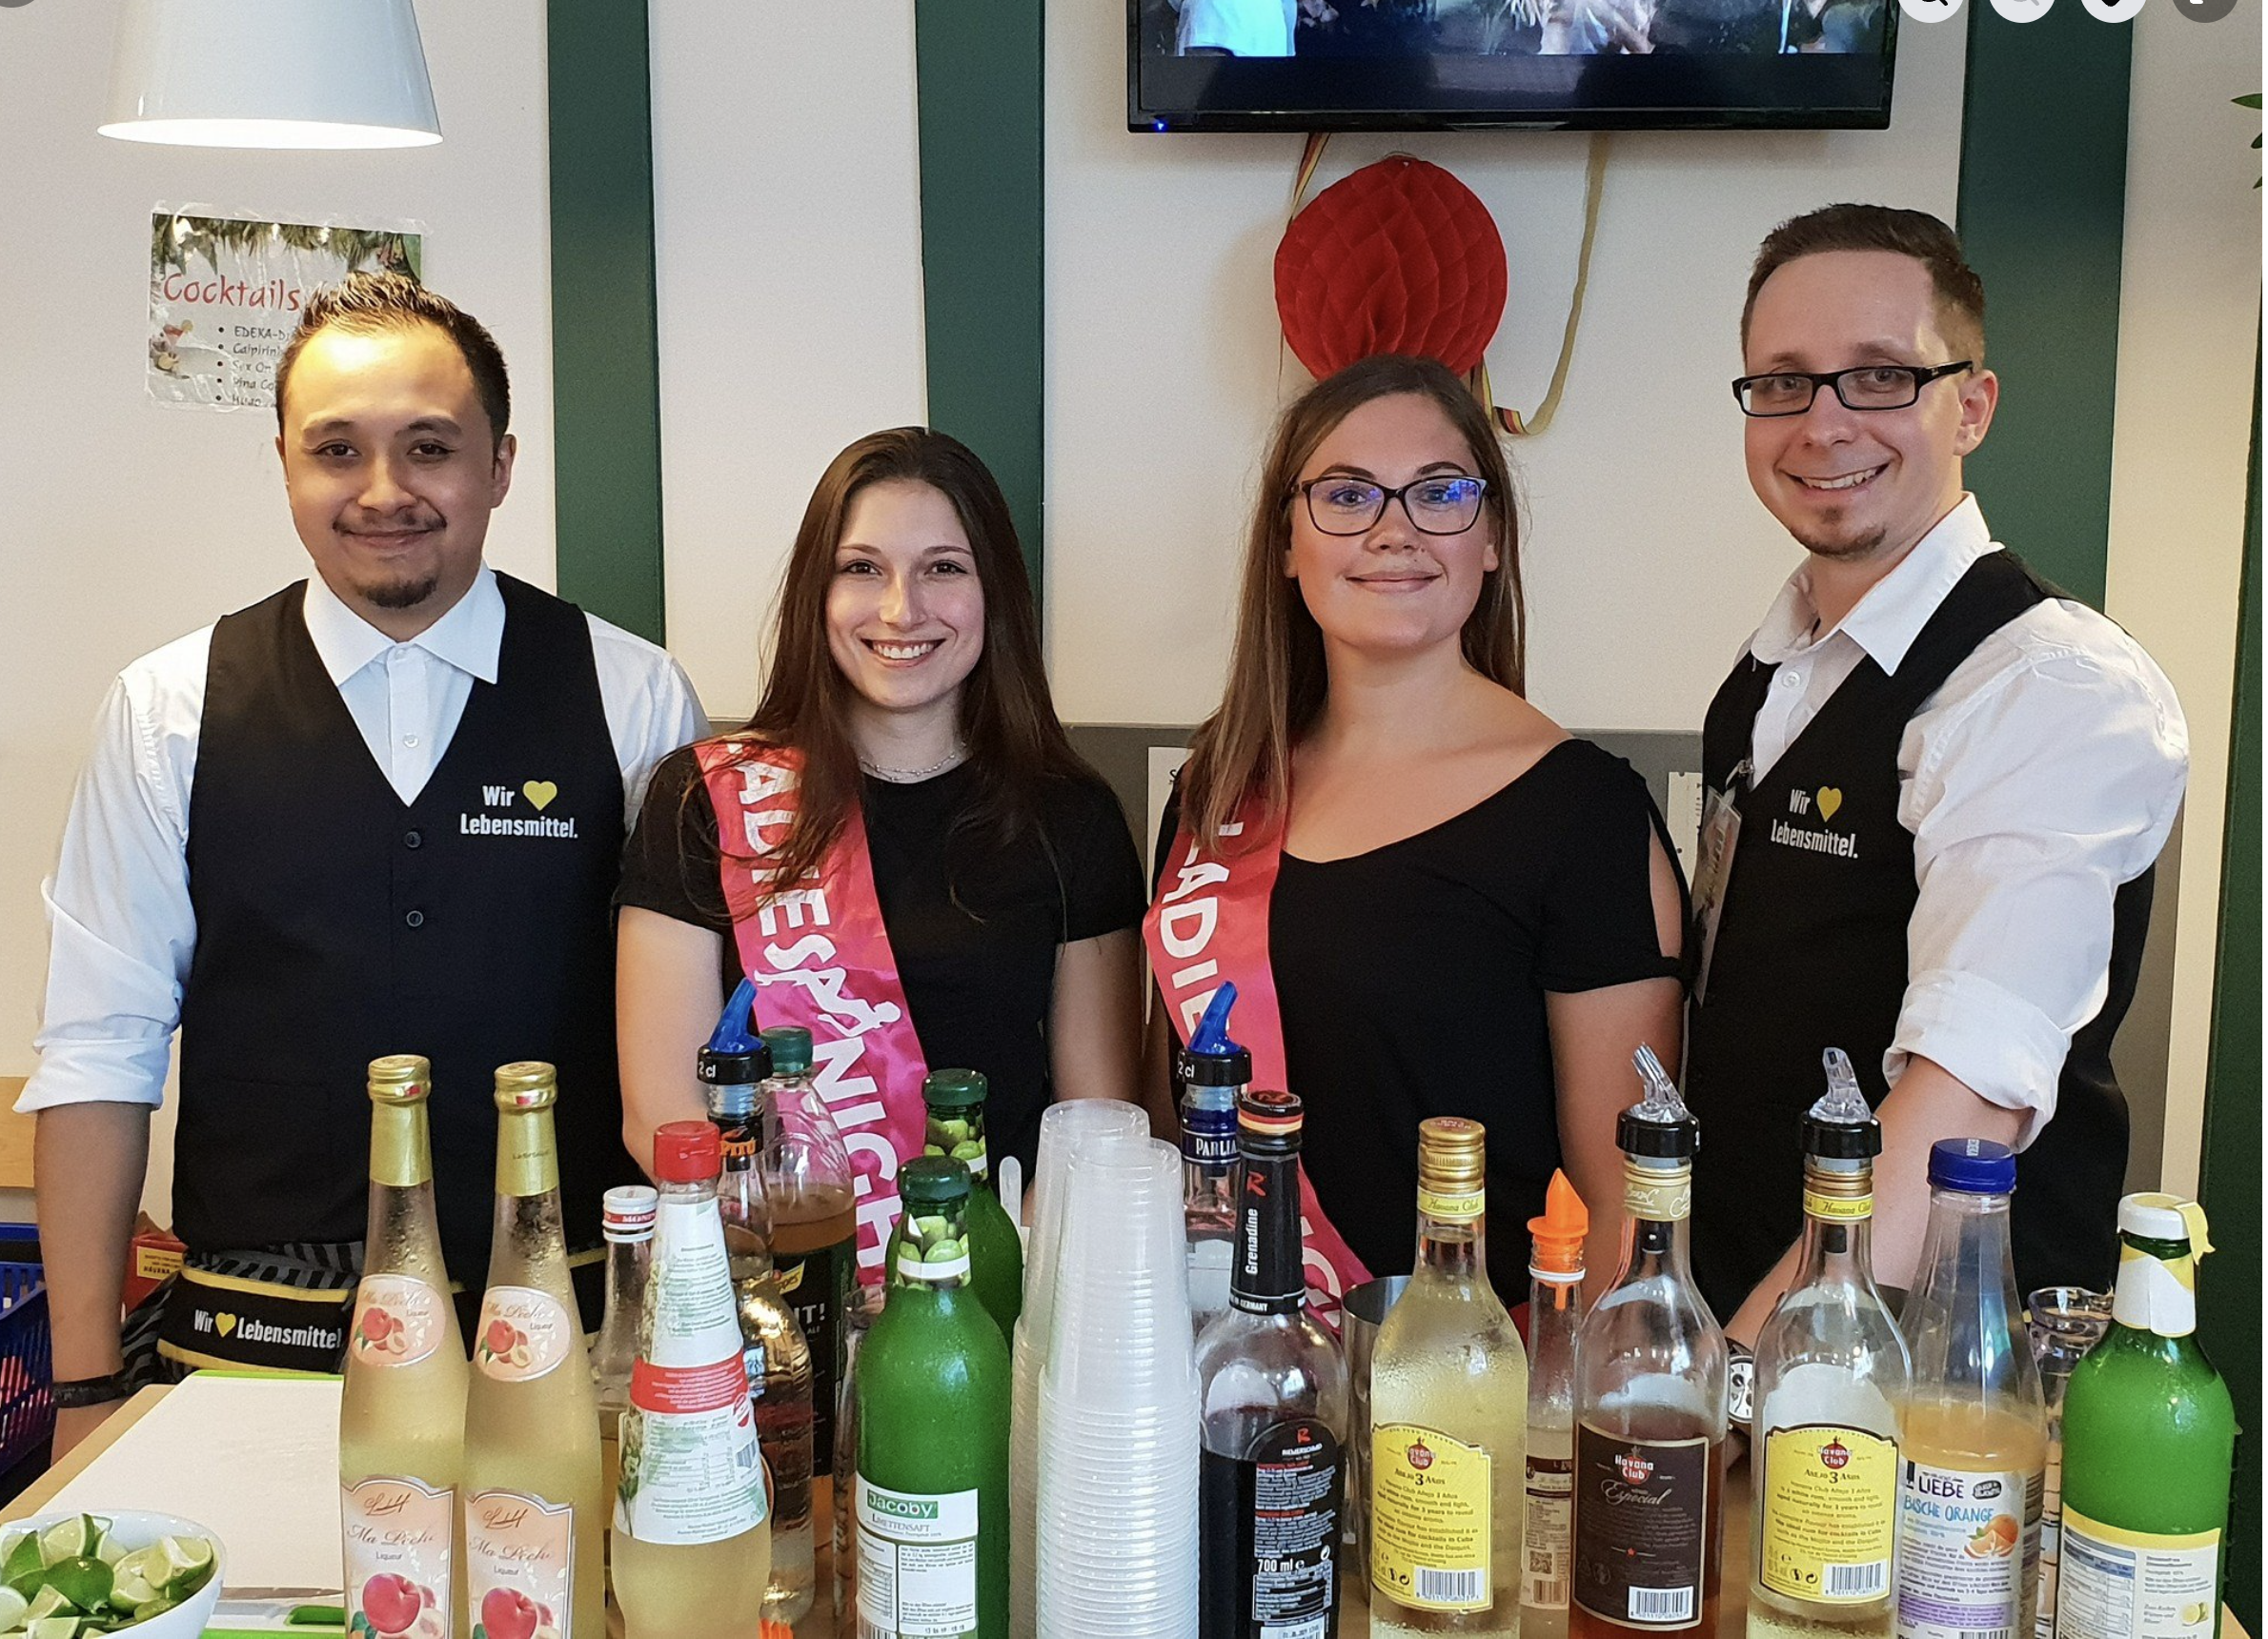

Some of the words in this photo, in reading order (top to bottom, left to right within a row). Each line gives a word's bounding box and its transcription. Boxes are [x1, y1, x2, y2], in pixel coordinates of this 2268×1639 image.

[163, 273, 302, 312] Cocktails
[481, 785, 516, 807] Wir
[1789, 788, 1811, 815] Wir
[460, 813, 578, 839] Lebensmittel.
[1770, 819, 1859, 860] Lebensmittel.
[705, 1064, 717, 1078] cl
[1185, 1064, 1195, 1078] cl
[1245, 1208, 1258, 1275] Grenadine
[193, 1308, 213, 1333] Wir
[1614, 1454, 1654, 1471] Havana
[1824, 1456, 1845, 1466] Club
[1415, 1472, 1424, 1486] 3
[1622, 1467, 1645, 1480] Club
[1829, 1471, 1838, 1484] 3
[1918, 1475, 1964, 1499] LIEBE
[868, 1491, 933, 1518] Jacoby
[1945, 1505, 1995, 1523] ORANGE
[1258, 1559, 1277, 1574] 700
[1280, 1558, 1293, 1572] ml
